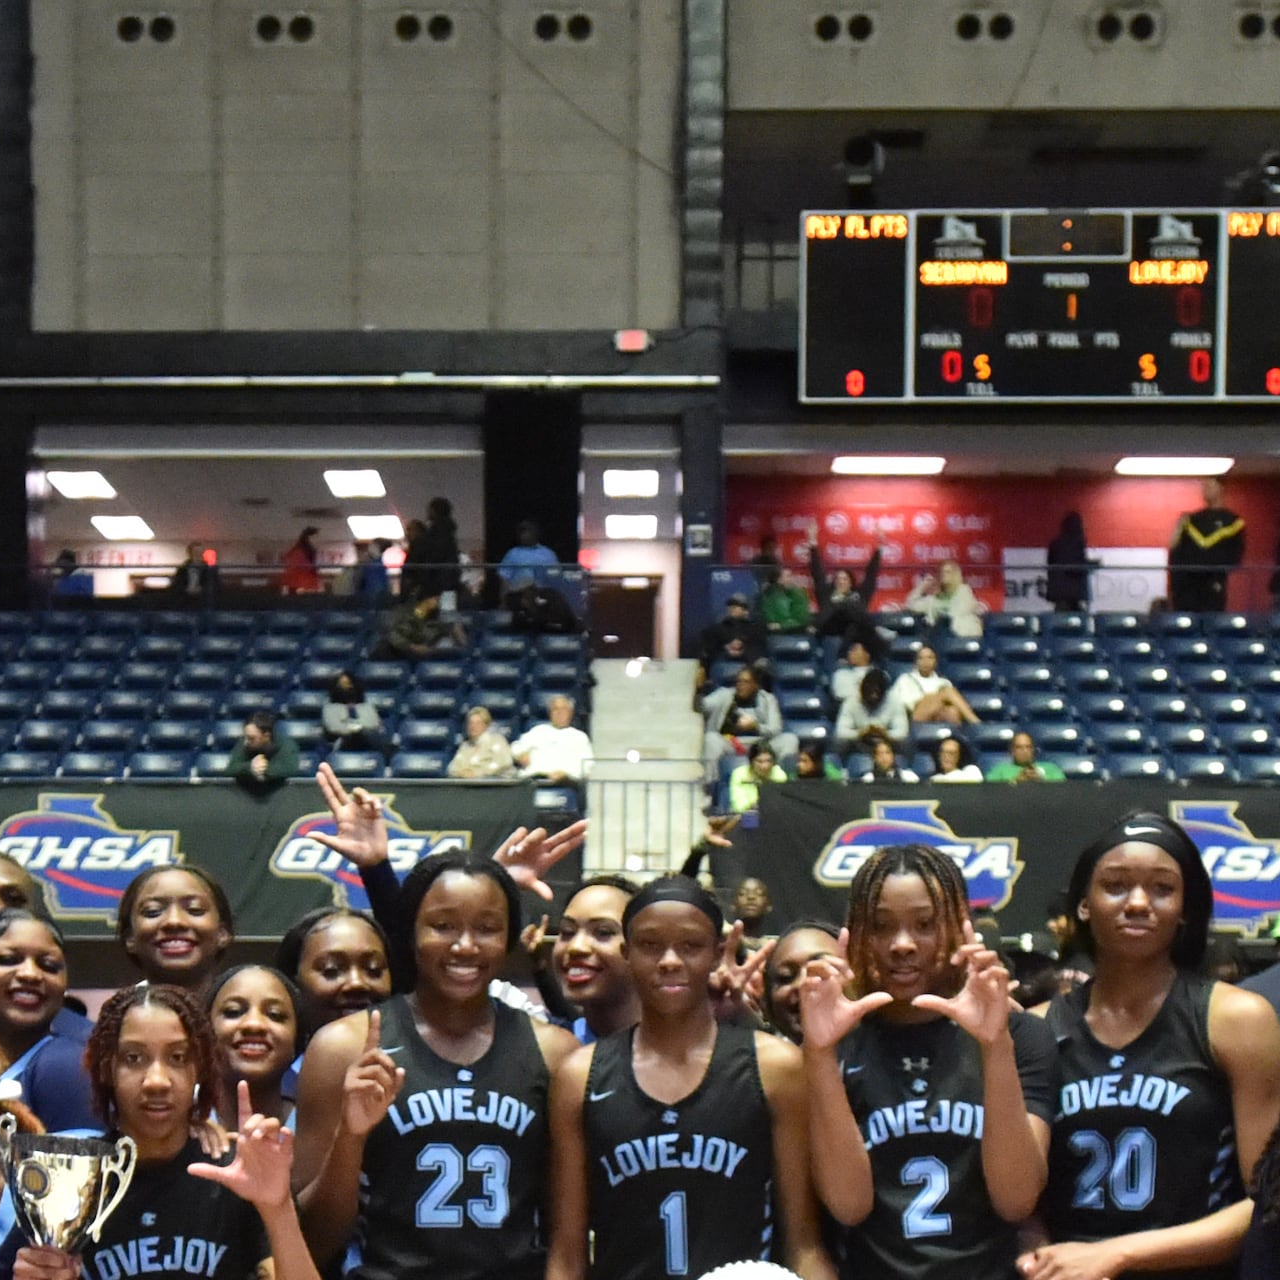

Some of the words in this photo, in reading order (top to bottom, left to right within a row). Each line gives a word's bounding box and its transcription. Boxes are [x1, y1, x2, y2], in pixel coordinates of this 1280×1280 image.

[806, 215, 841, 239] PLY
[1228, 212, 1263, 236] PLY
[1129, 260, 1208, 284] LOVEJOY
[941, 350, 963, 382] 0
[1189, 350, 1210, 382] 0
[387, 1087, 536, 1136] LOVEJOY
[1055, 1073, 1192, 1122] OVEJOY
[600, 1132, 748, 1187] LOVEJOY
[1069, 1125, 1158, 1211] 20
[415, 1142, 511, 1228] 23
[901, 1155, 953, 1239] 2
[659, 1191, 689, 1276] 1
